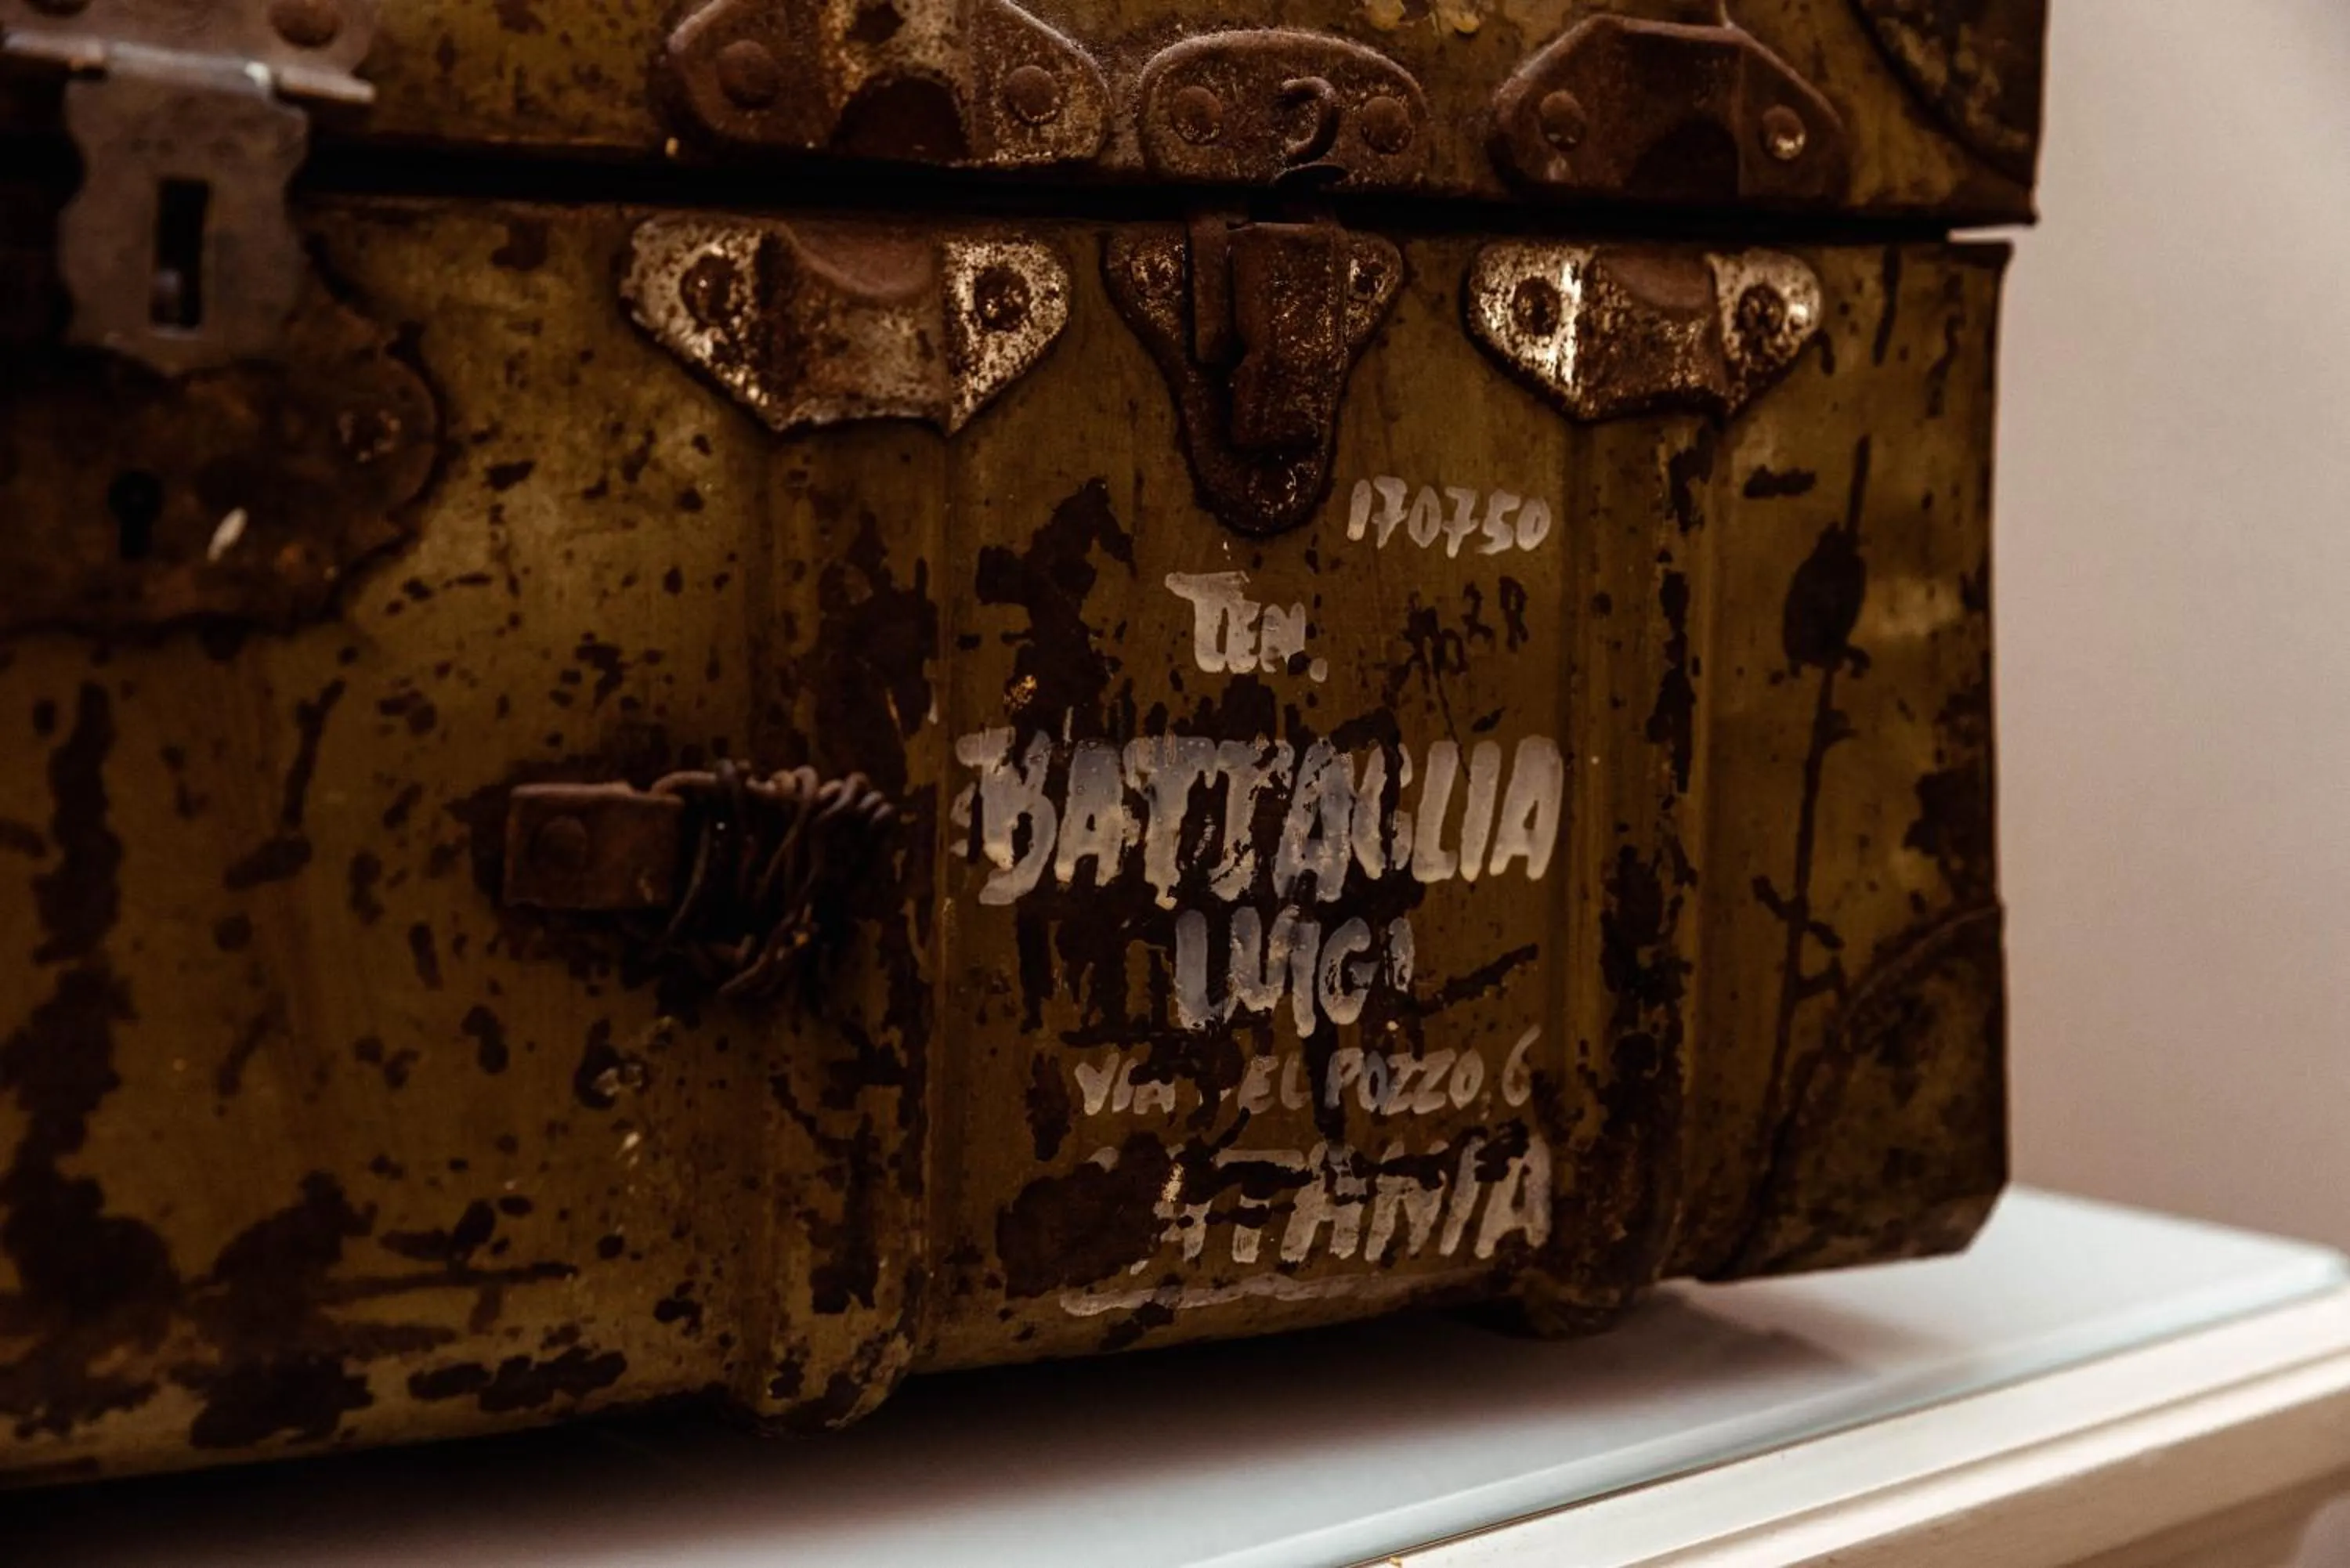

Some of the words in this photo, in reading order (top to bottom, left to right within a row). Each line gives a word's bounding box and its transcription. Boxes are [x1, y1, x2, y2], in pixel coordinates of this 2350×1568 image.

[1347, 475, 1552, 559] 170750
[1074, 1053, 1177, 1116] VIA
[1501, 1024, 1542, 1108] 6
